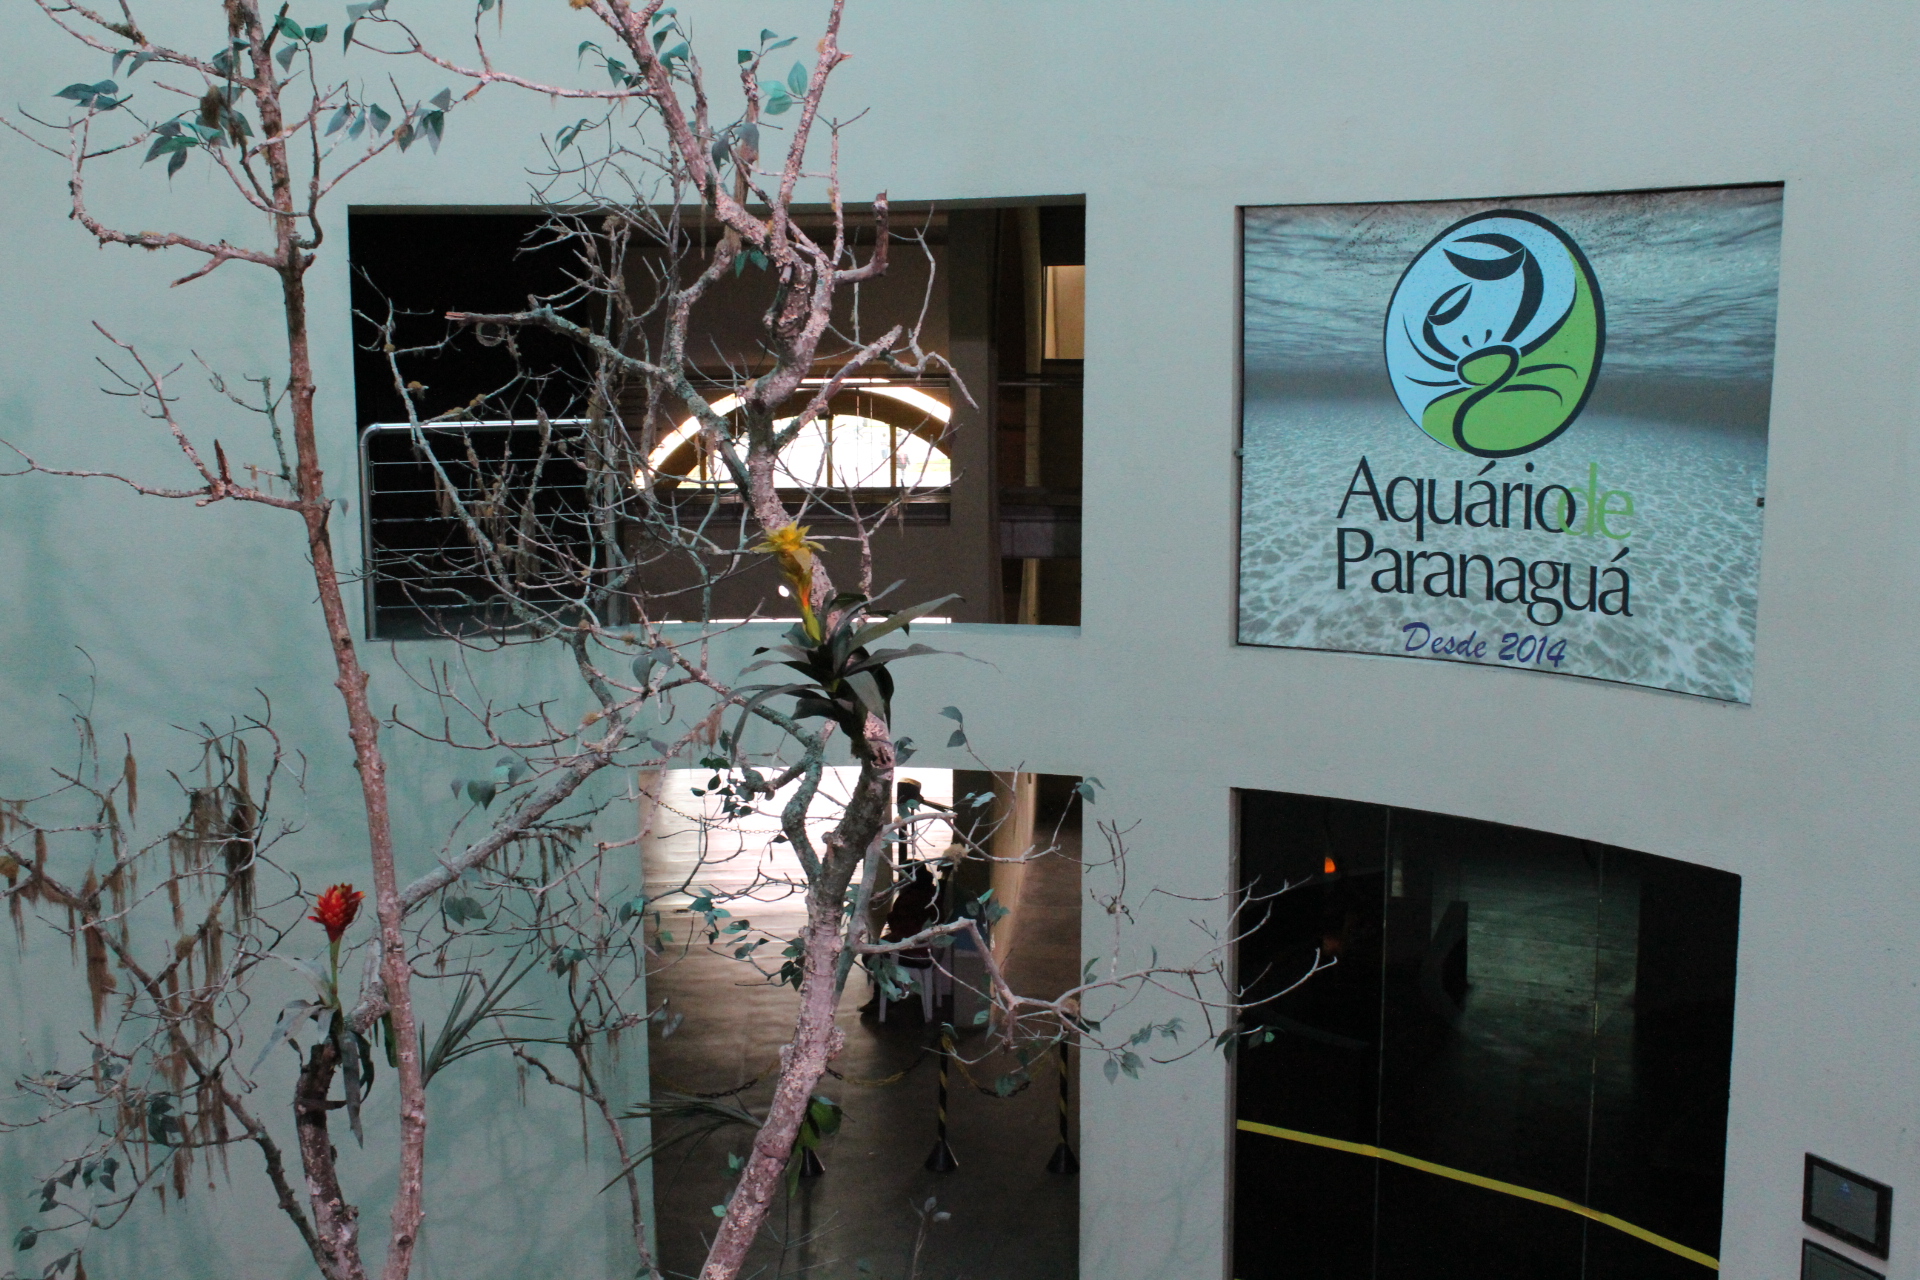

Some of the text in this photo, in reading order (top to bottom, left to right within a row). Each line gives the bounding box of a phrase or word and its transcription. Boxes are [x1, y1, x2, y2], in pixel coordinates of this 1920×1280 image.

[1336, 455, 1635, 541] Aquário de
[1336, 527, 1634, 627] Paranaguá
[1402, 622, 1567, 668] Desde 2014
